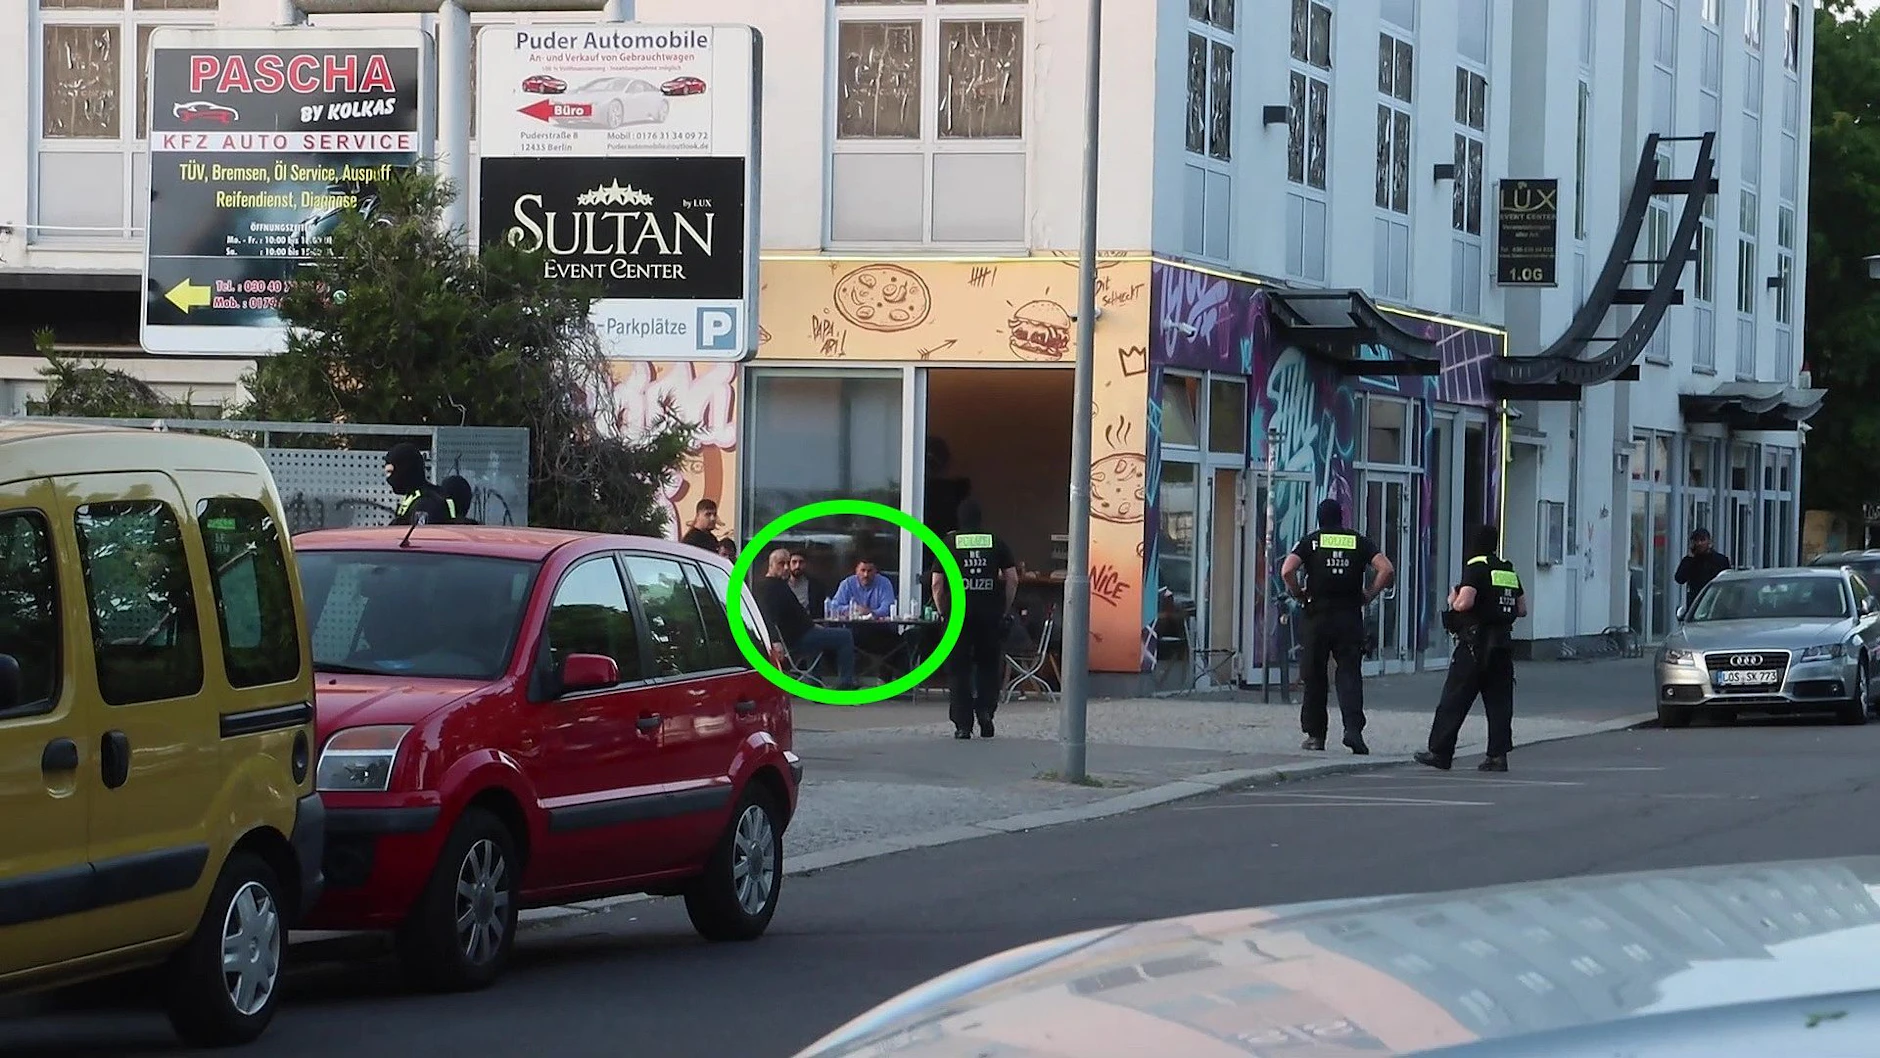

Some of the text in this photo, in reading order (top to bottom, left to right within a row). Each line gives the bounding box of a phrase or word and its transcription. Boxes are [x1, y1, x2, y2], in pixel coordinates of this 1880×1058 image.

[516, 30, 708, 50] Puder Automobile
[546, 53, 564, 62] und
[565, 52, 600, 62] Verkauf
[600, 54, 617, 62] von
[619, 52, 695, 64] Gebrauchtwagen
[189, 54, 396, 93] PASCHA
[300, 97, 396, 123] BY KOLKAS
[553, 104, 585, 116] Büro
[163, 134, 410, 150] KFZ AUTO SERVICE
[520, 131, 579, 140] Puderstraße 8
[607, 131, 631, 140] Mobil
[636, 131, 658, 140] 0176
[659, 131, 669, 140] 31
[672, 131, 683, 140] 34
[685, 131, 696, 140] 09
[698, 131, 708, 140] 72
[520, 143, 573, 151] 12435 Berlin
[179, 159, 392, 186] TÜV, Bremsen, Öl Service, Auspuff
[216, 190, 358, 211] Reifendienst, Diagnose
[682, 199, 712, 209] by LUX
[507, 193, 715, 257] SULTAN
[265, 236, 286, 245] 10:00
[265, 247, 286, 256] 10:00
[543, 257, 687, 280] EVENT CENTER
[215, 279, 236, 293] Tel.
[243, 279, 266, 293] 030
[266, 279, 282, 293] 40
[213, 296, 241, 309] Mob.
[962, 577, 994, 591] OLIZEI
[1759, 671, 1777, 682] 773
